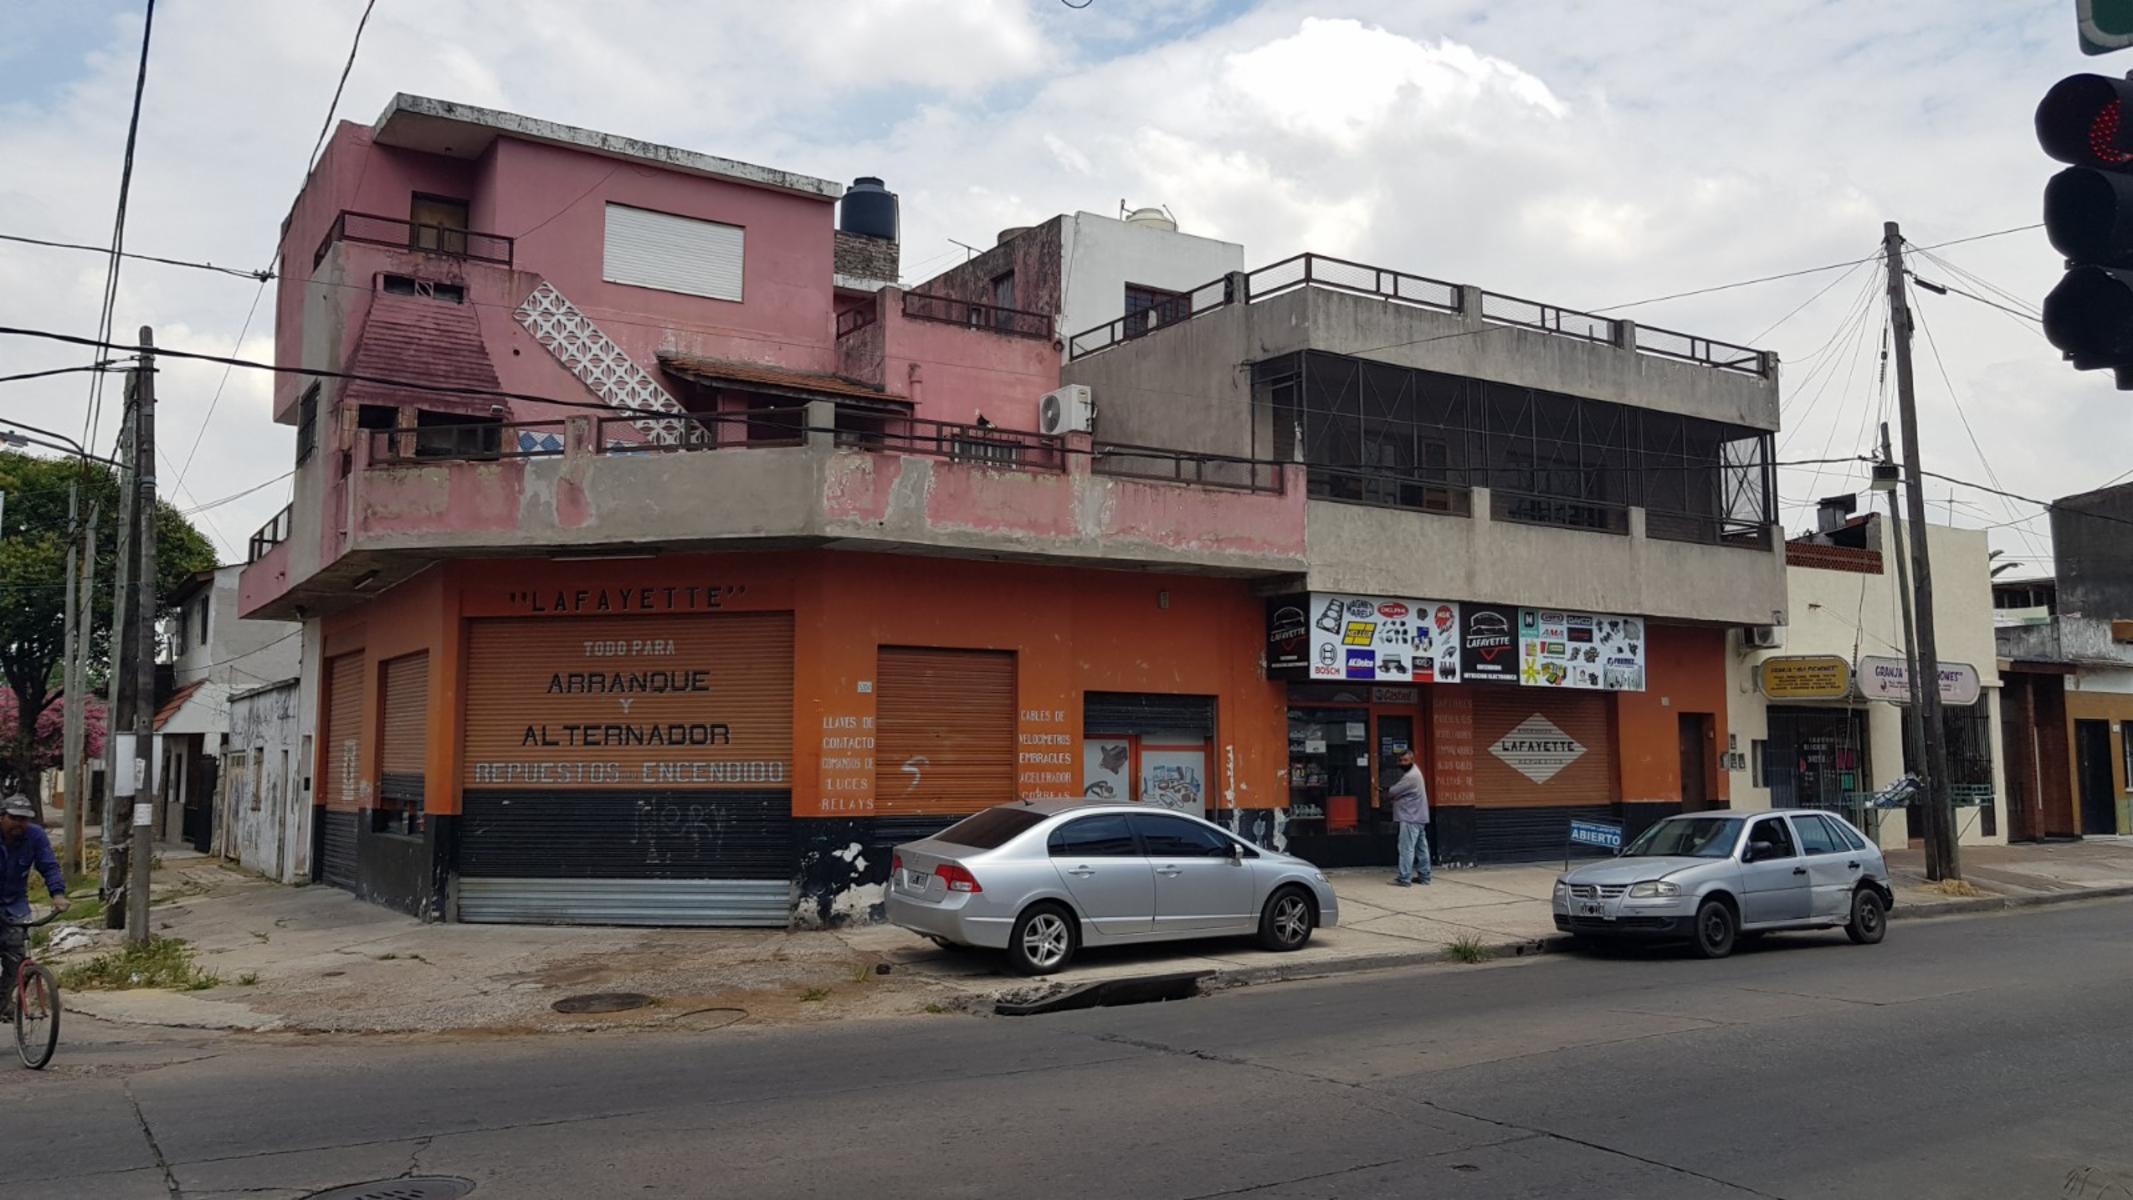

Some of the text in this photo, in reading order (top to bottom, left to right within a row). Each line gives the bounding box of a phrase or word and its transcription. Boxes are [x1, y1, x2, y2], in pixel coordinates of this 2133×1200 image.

[1466, 636, 1510, 648] LAFAYETTE
[584, 640, 676, 657] TODO PARA
[1314, 666, 1341, 676] BOSCH
[546, 671, 710, 694] ARRANQUE
[619, 698, 634, 714] Y
[1020, 710, 1065, 722] CABLES DE
[823, 716, 874, 729] LLAVES DE
[522, 723, 731, 746] ALTERNADOR
[823, 737, 874, 749] CONTACTO
[1502, 741, 1575, 752] LAFAYETTE
[474, 761, 786, 784] REPUESTOS ENCENDIDO
[1019, 772, 1072, 784] ACELERADOR
[826, 778, 868, 790] LUCES
[821, 798, 874, 810] RELAYS
[1571, 829, 1621, 846] ABIERTO
